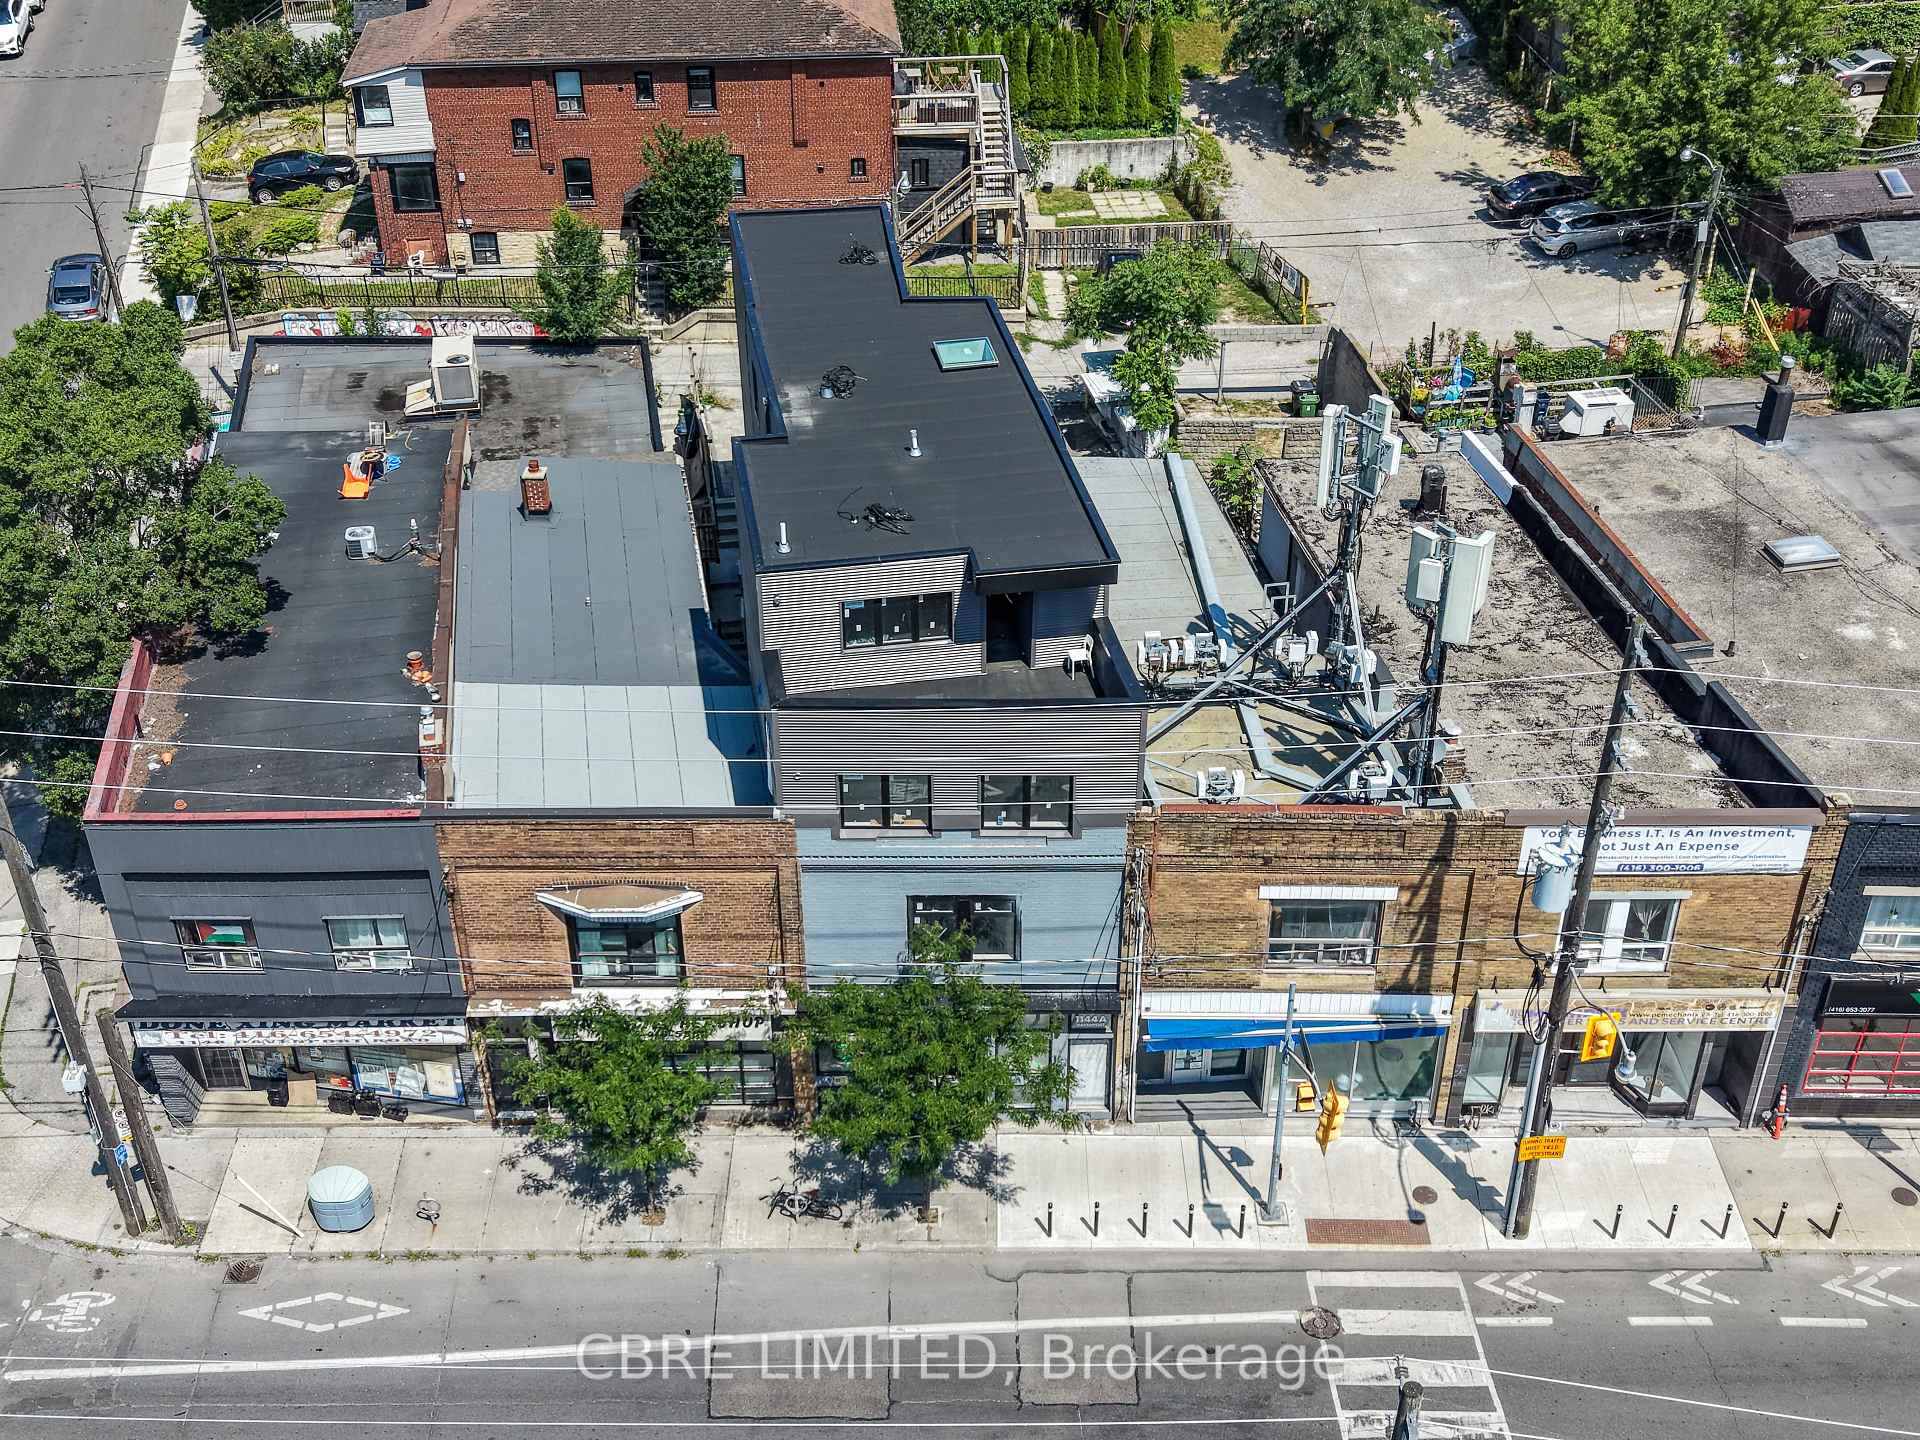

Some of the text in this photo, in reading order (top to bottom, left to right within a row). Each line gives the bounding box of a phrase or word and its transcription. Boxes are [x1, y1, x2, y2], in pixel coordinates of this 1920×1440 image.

[1540, 829, 1572, 839] Yor
[1645, 829, 1665, 838] I.T.
[1669, 829, 1681, 838] Is
[1684, 829, 1704, 838] An
[1709, 828, 1795, 839] Investment,
[1620, 842, 1651, 851] Just
[1654, 842, 1674, 851] An
[1679, 842, 1740, 853] Expense
[1628, 1017, 1657, 1025] AND
[1662, 1017, 1717, 1025] SERVICE
